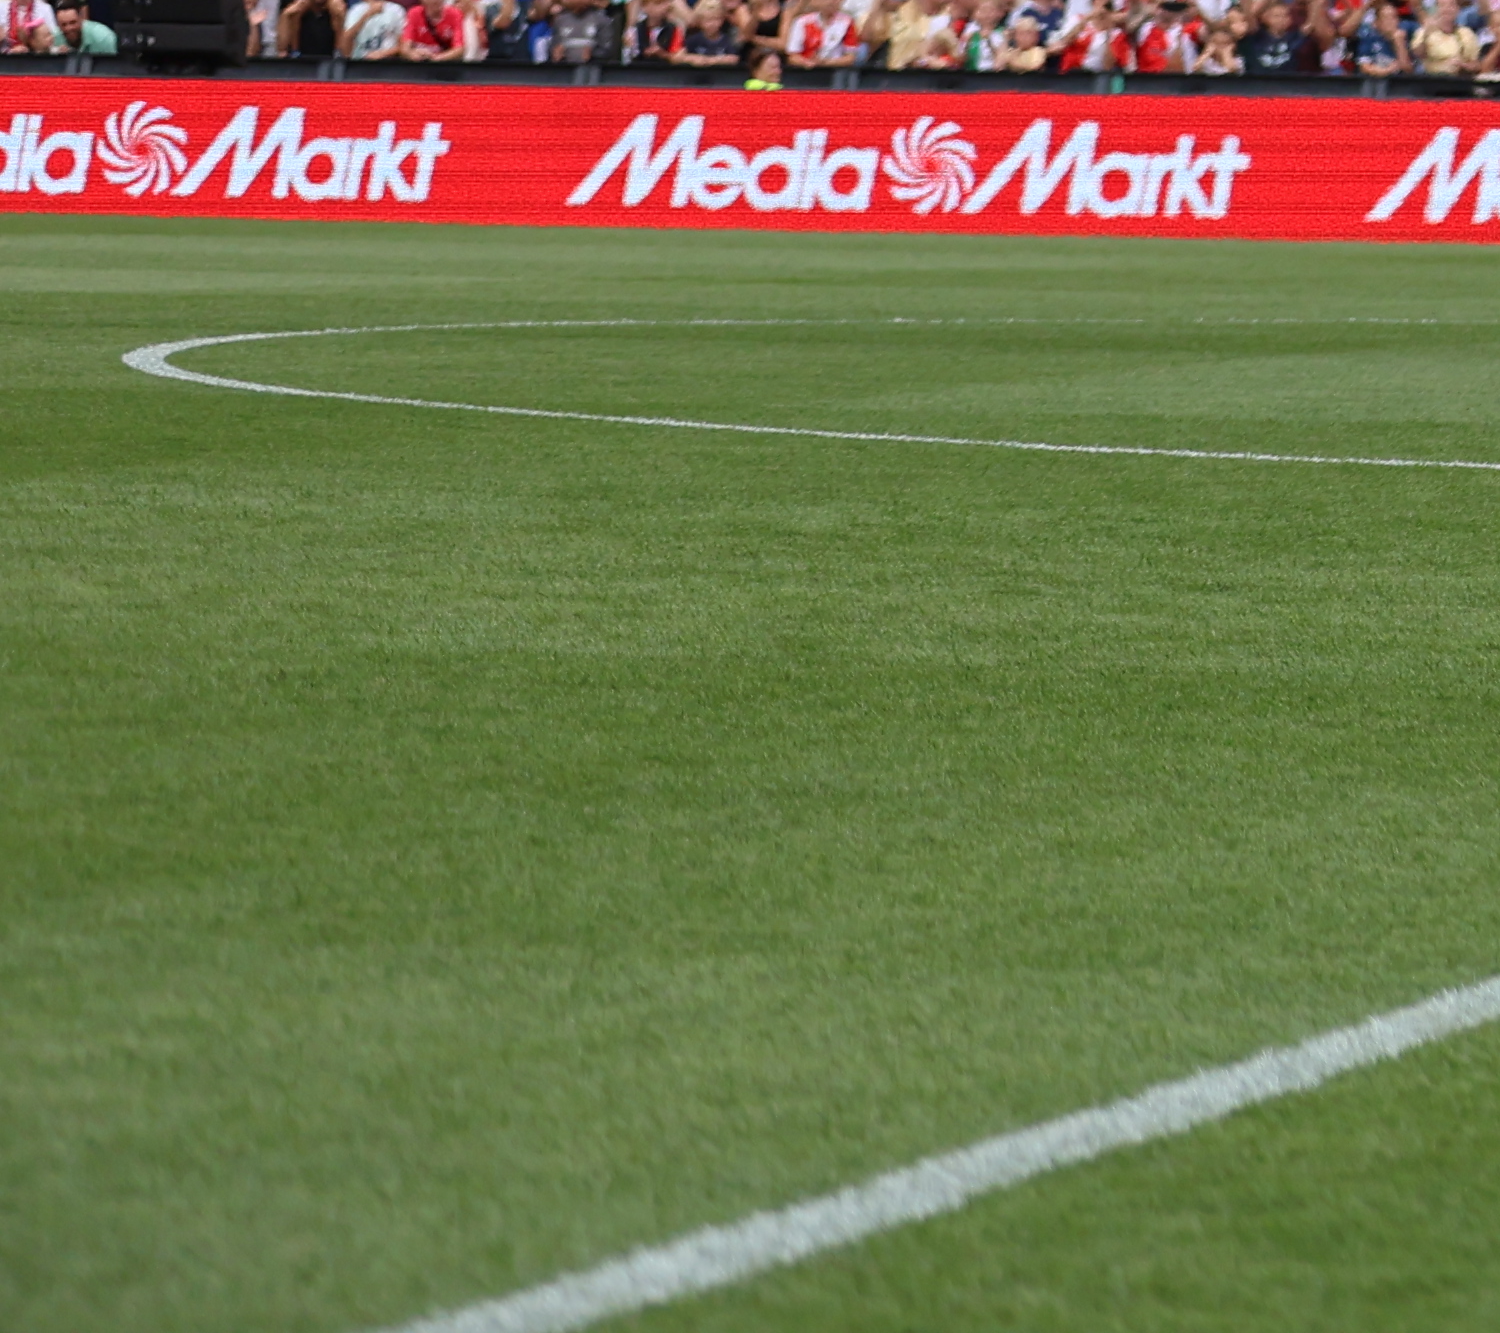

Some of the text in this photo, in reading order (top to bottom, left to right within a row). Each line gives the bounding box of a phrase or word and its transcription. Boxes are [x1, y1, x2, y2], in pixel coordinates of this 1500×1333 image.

[170, 106, 450, 202] Markt
[566, 114, 1251, 220] Media Markt
